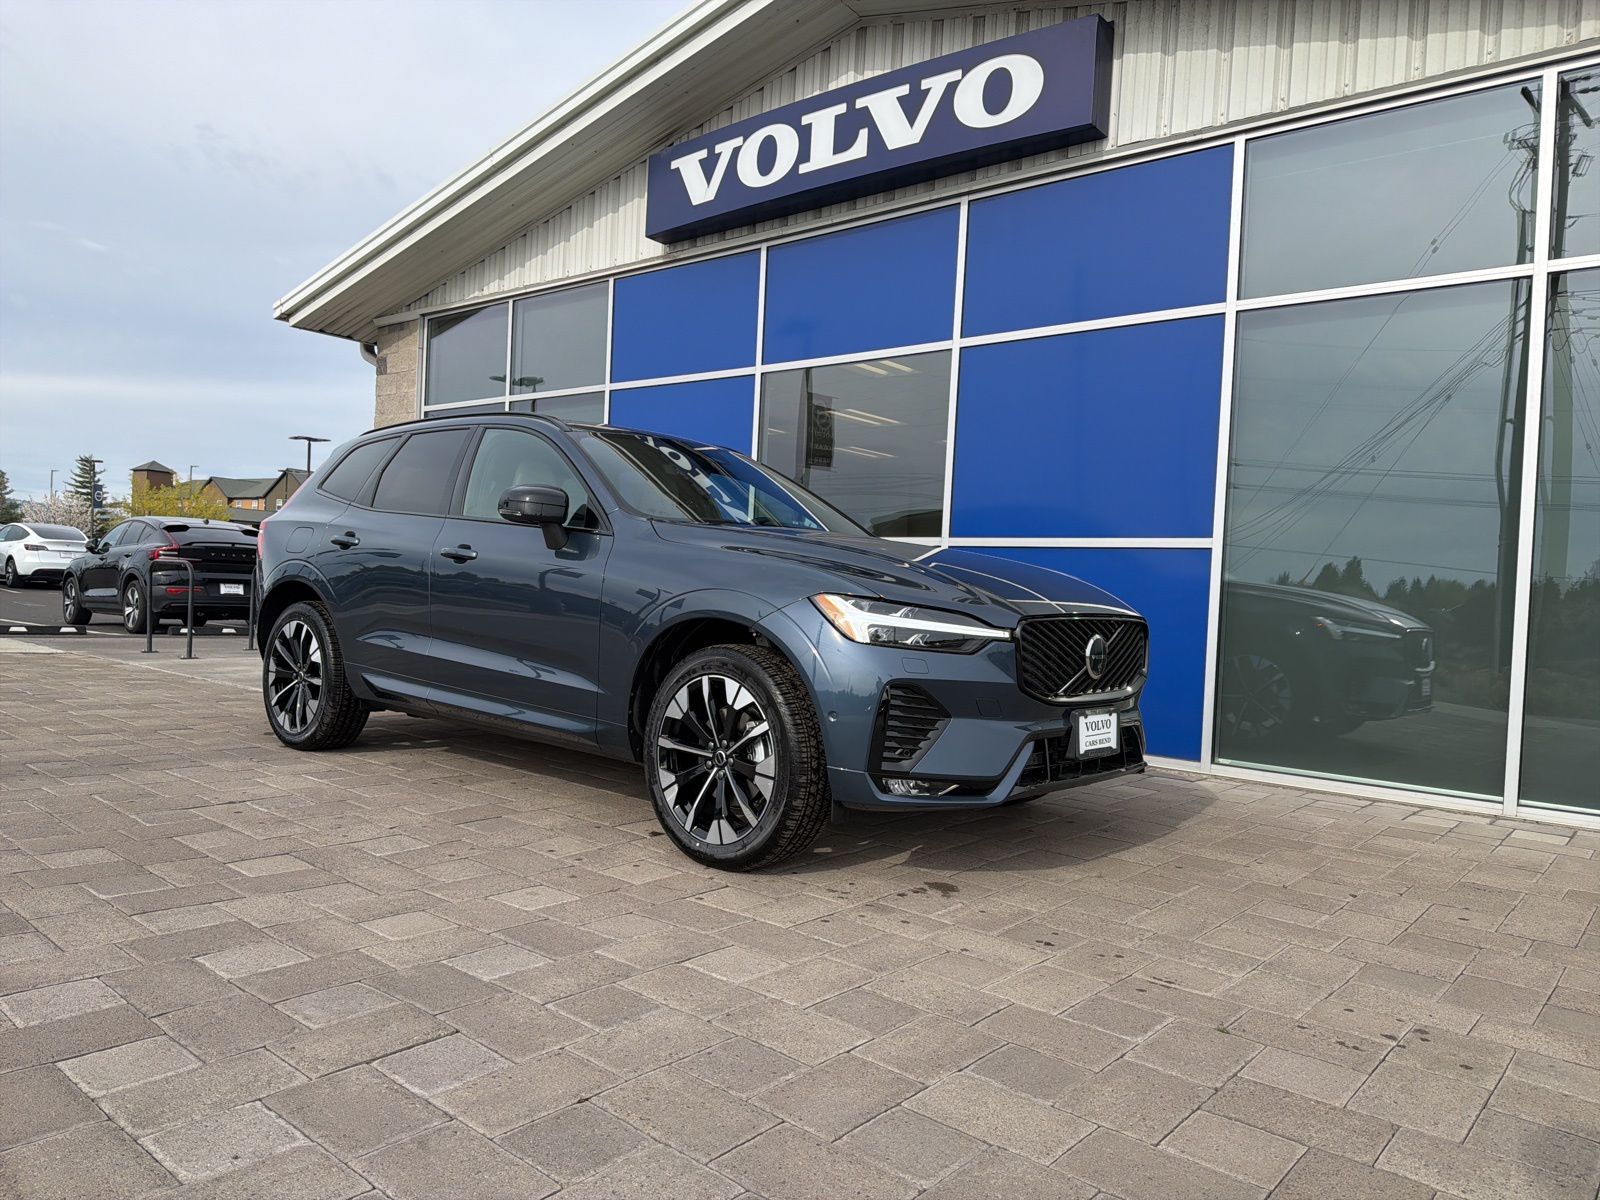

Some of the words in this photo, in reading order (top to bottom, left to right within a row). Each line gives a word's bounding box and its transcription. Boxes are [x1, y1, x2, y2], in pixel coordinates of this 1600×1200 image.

[671, 54, 1044, 206] VOLVO
[1085, 719, 1111, 731] VOLVO
[1085, 739, 1098, 747] CARS
